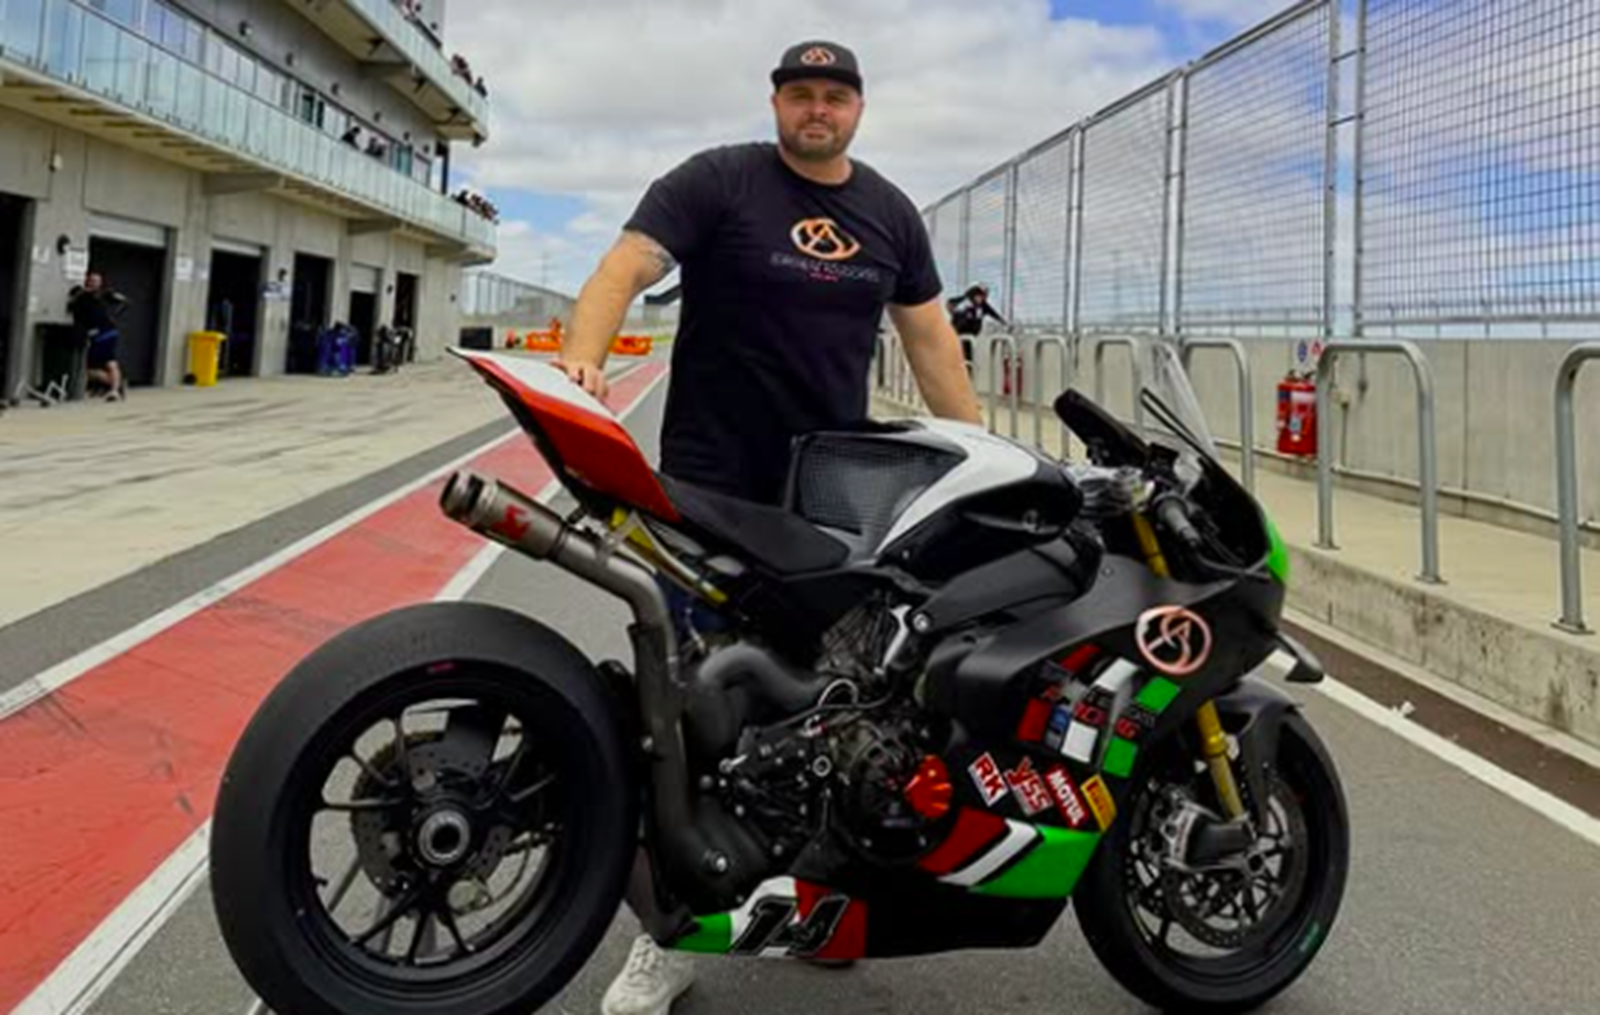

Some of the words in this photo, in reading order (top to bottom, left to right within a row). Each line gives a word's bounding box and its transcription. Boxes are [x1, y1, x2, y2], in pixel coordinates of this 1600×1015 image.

[974, 754, 1004, 799] RK
[1005, 756, 1051, 812] YSS
[1049, 768, 1085, 826] MOTUL
